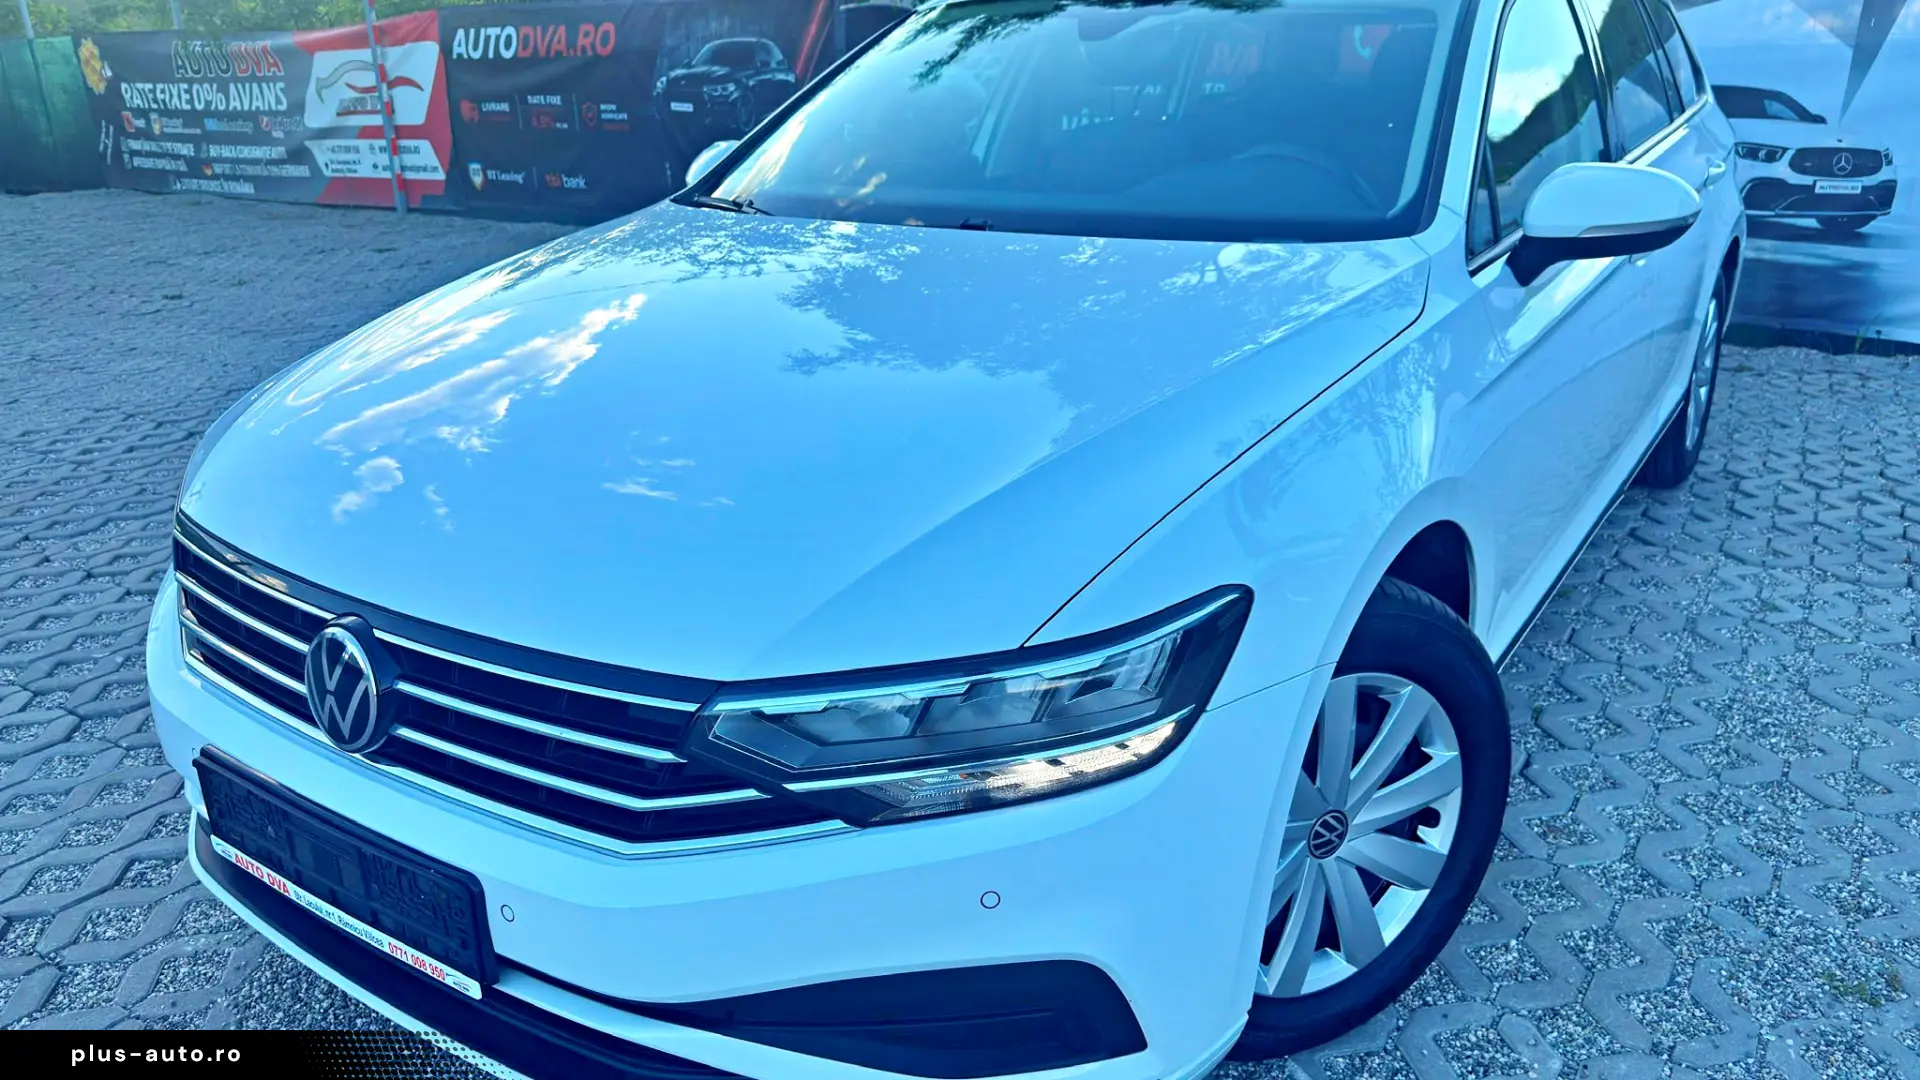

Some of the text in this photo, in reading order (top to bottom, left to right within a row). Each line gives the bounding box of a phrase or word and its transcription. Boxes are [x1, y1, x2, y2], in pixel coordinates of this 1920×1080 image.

[452, 22, 616, 60] AUTODVA.RO
[121, 82, 288, 111] RATE FIXE 0% AVANS
[482, 102, 510, 112] LIVRARE
[561, 173, 588, 189] bank
[234, 853, 265, 879] AUTO
[267, 871, 291, 896] DVA
[388, 941, 409, 962] 0771
[410, 954, 427, 971] 008
[429, 963, 446, 981] 950
